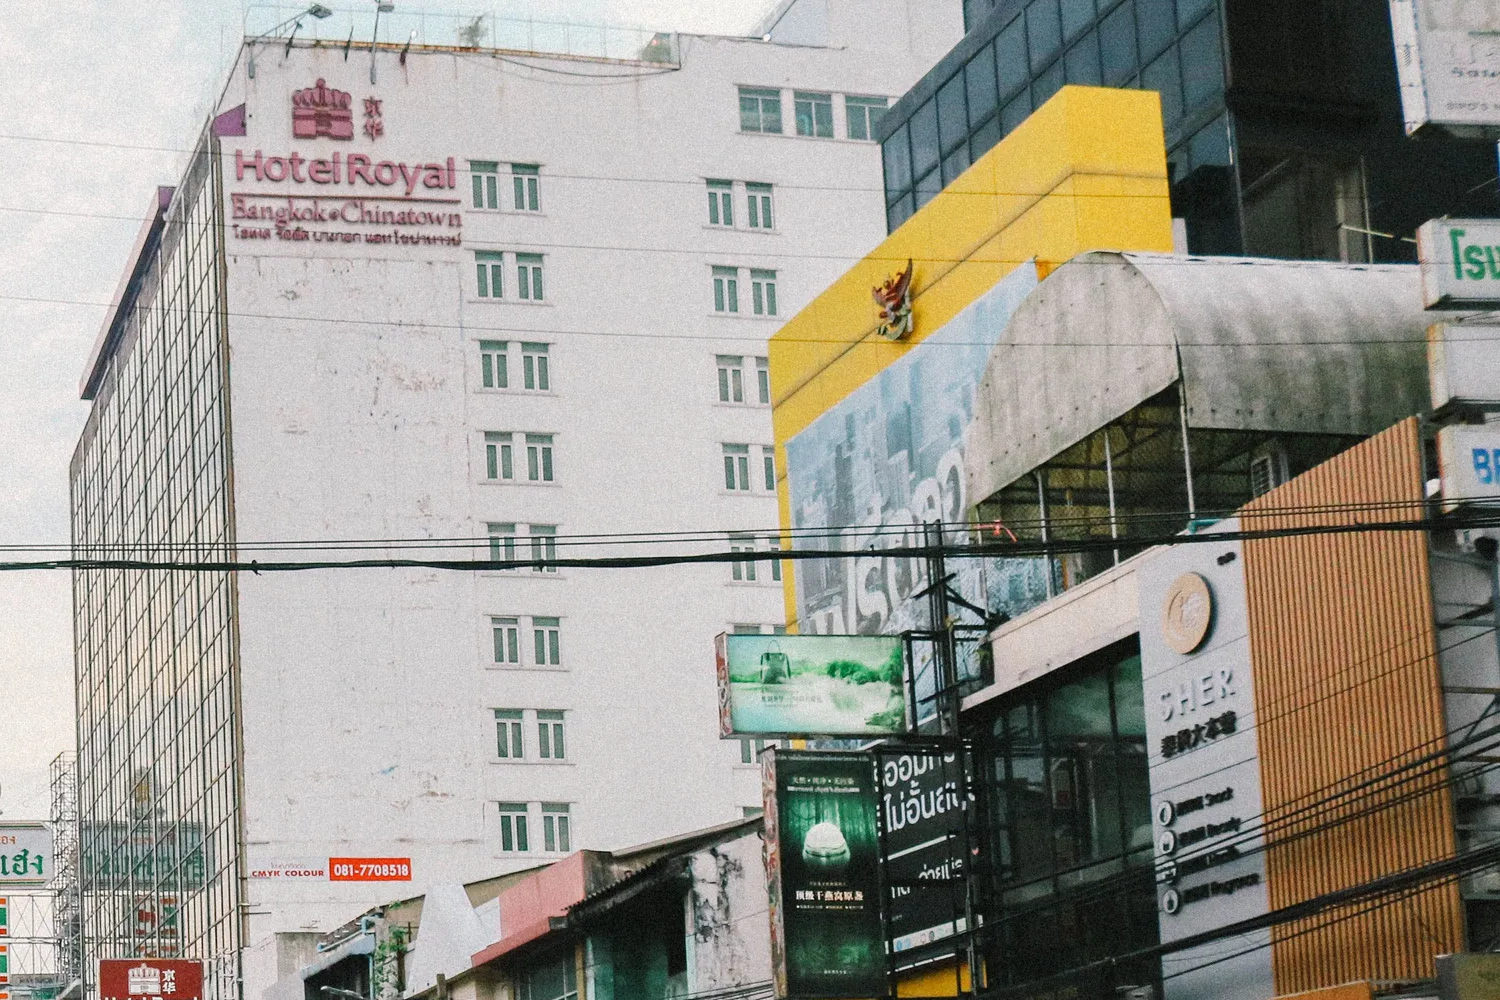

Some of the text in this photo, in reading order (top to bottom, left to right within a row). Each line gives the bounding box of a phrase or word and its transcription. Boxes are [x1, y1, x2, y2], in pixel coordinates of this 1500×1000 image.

[235, 150, 456, 196] Hotel Royal
[334, 864, 409, 877] 081-7708518
